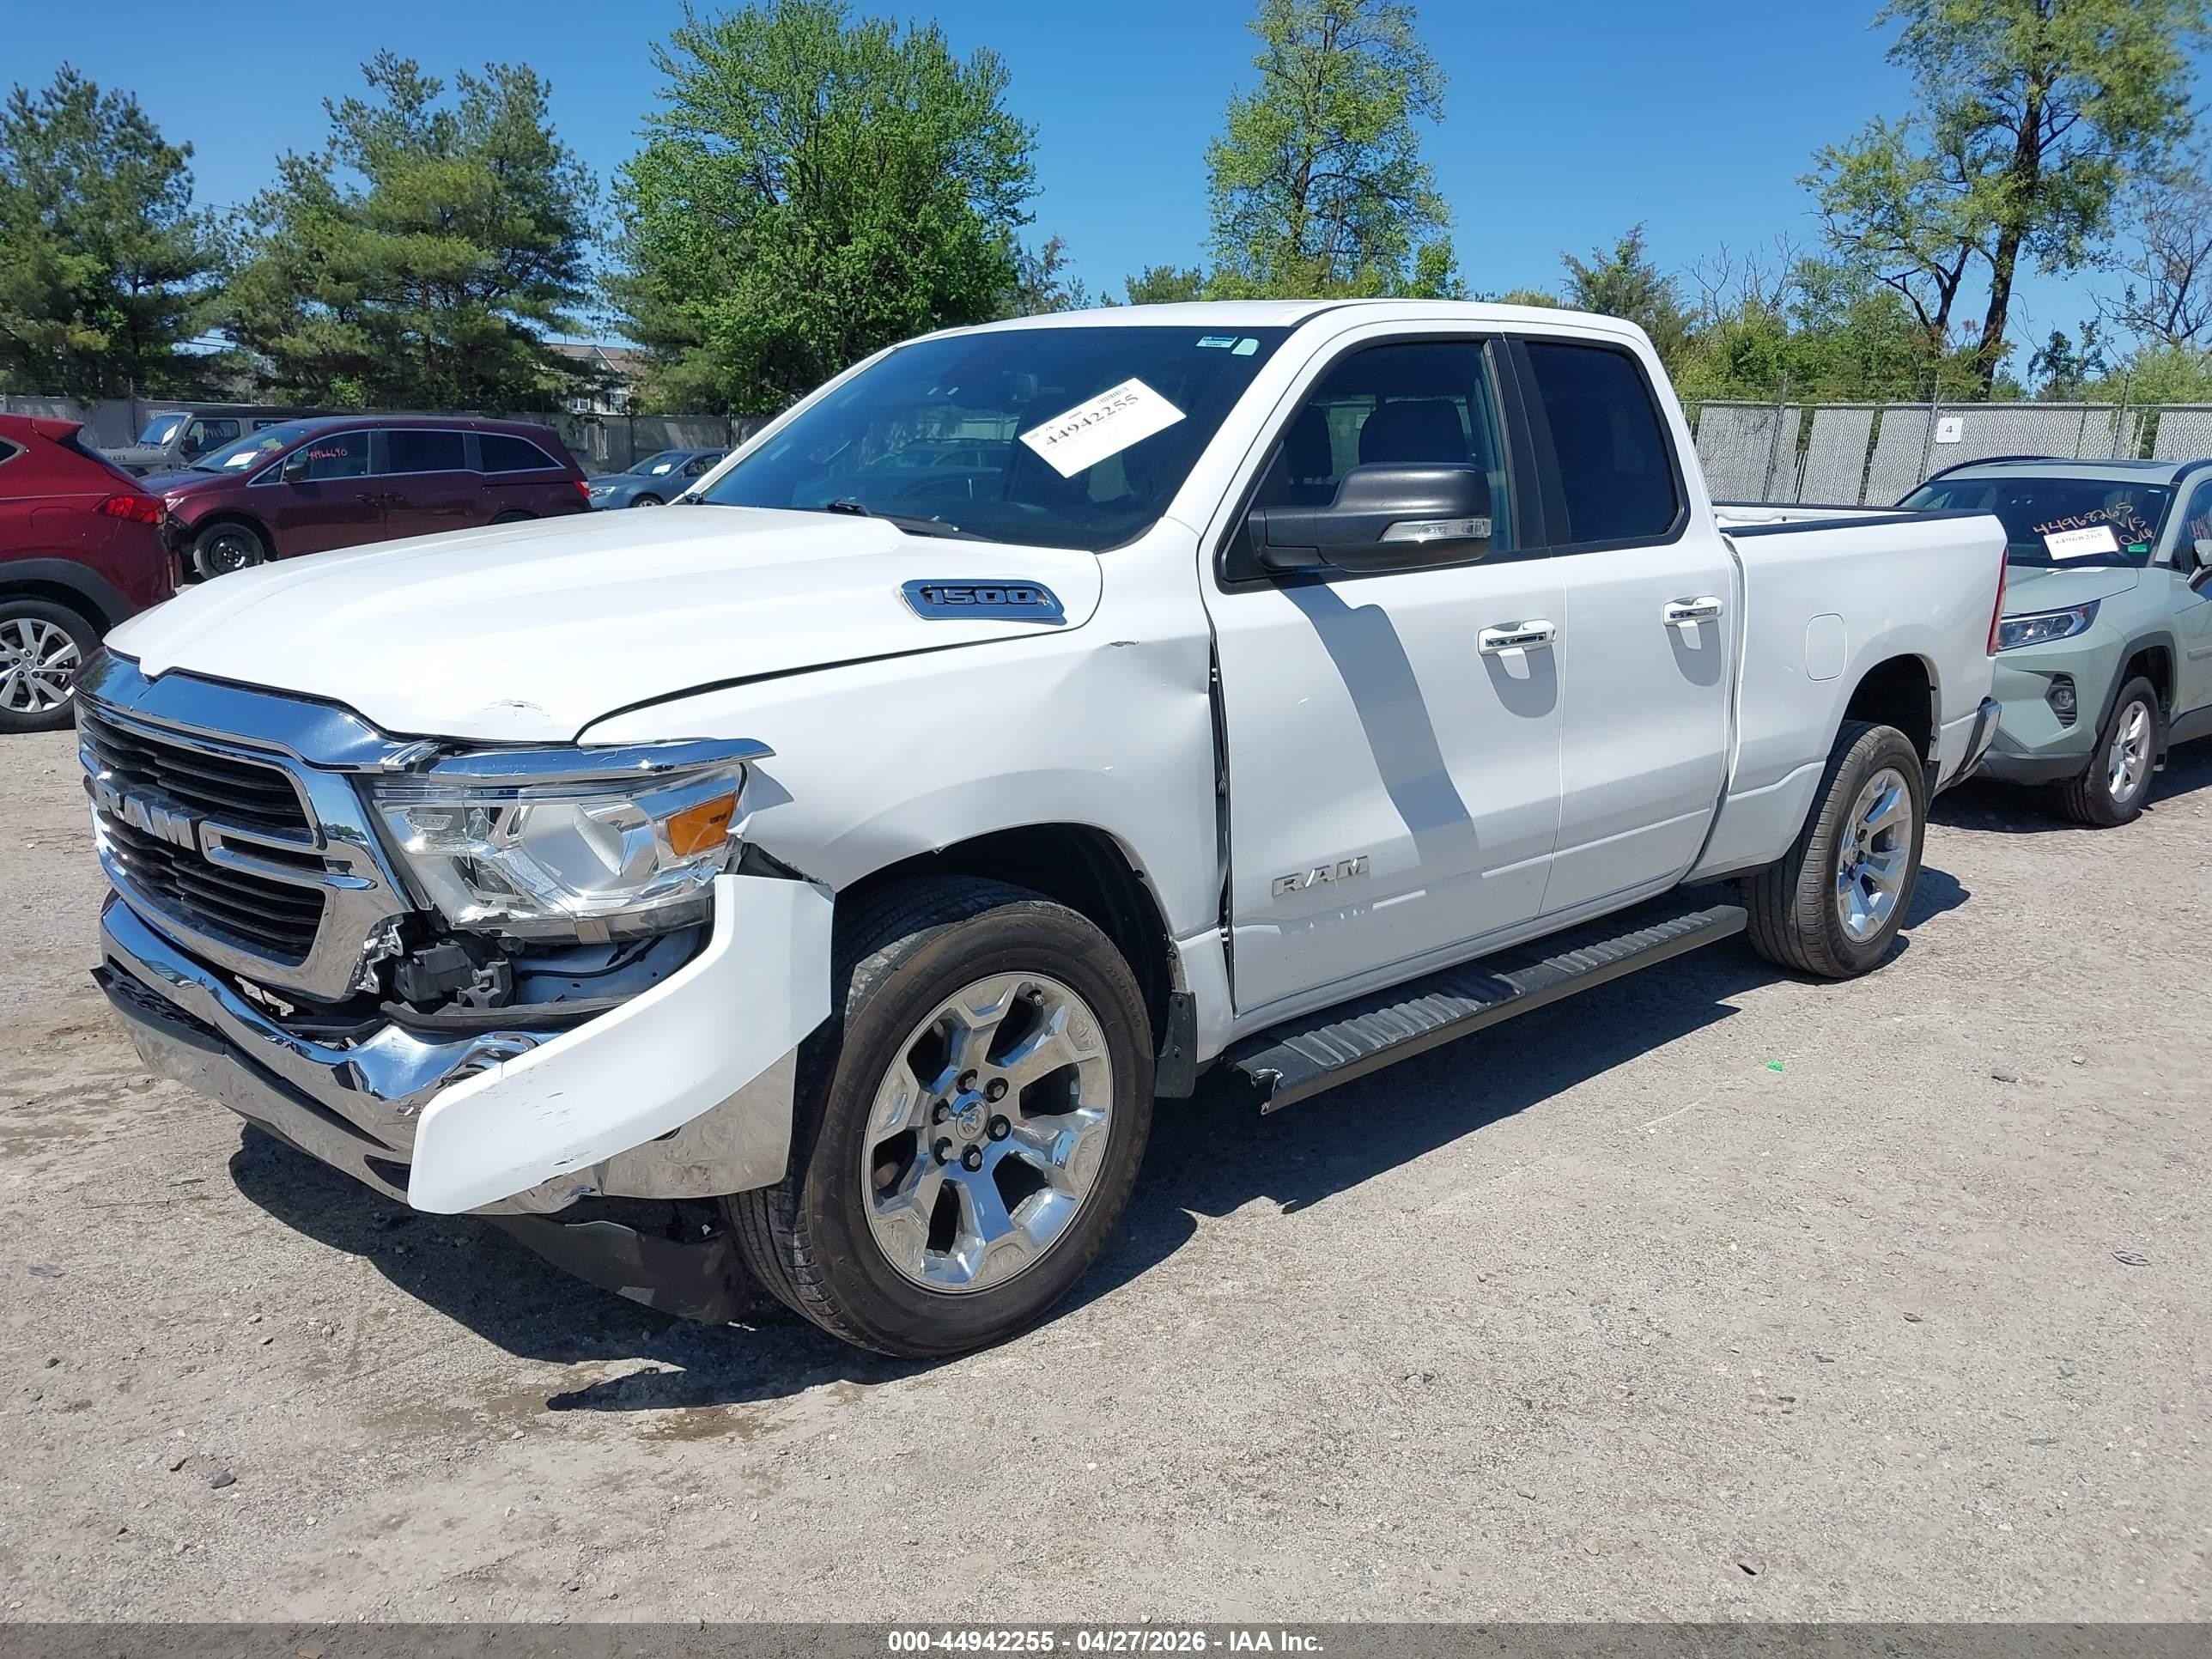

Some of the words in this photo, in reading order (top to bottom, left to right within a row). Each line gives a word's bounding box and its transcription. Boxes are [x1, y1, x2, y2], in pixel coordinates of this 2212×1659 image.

[1046, 393, 1139, 446] 44942255
[1945, 425, 1954, 434] 4
[2033, 501, 2134, 535] 44968265
[921, 587, 1038, 605] 1500
[94, 778, 198, 852] RAM
[1271, 855, 1370, 897] RAM
